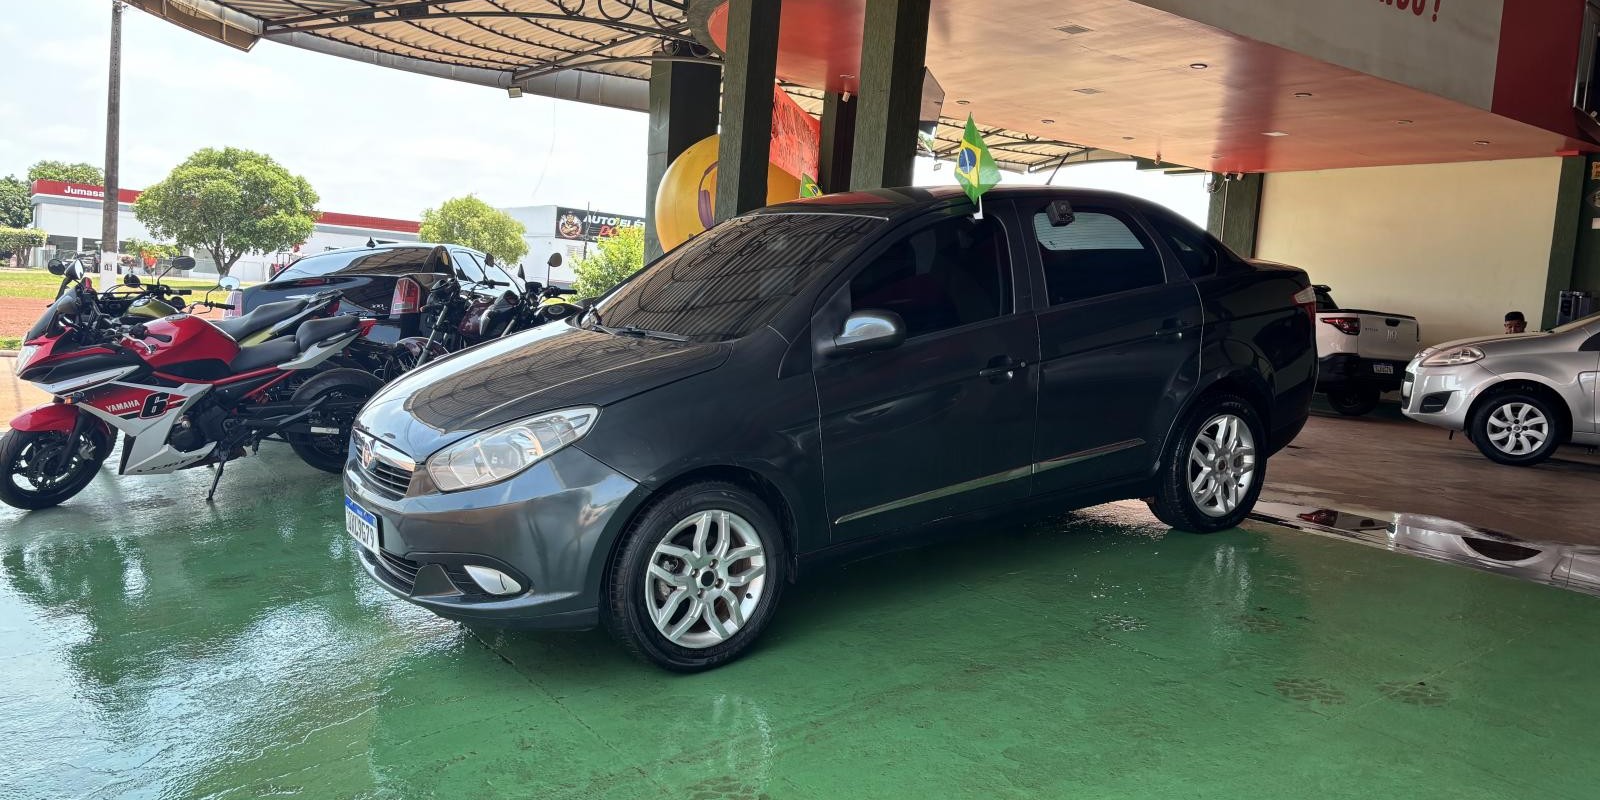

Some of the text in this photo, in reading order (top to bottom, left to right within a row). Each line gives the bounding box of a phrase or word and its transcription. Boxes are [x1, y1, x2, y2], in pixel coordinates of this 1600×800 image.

[64, 186, 104, 197] Jumasa
[583, 214, 617, 226] AUTO
[105, 399, 141, 412] YAMAHA
[141, 392, 169, 418] 6
